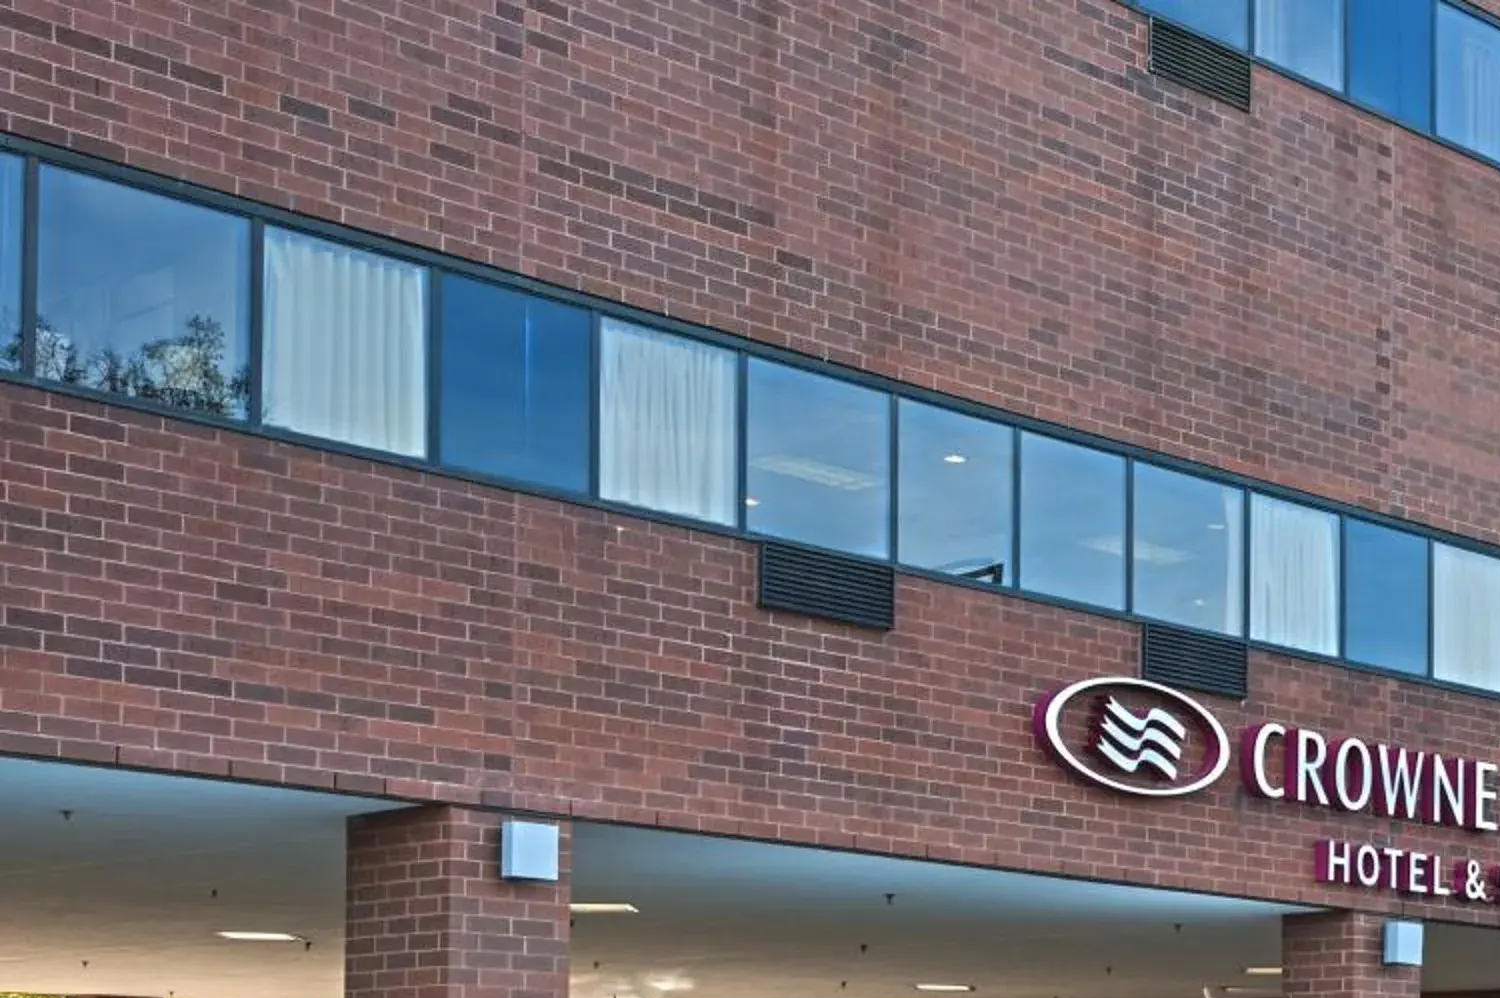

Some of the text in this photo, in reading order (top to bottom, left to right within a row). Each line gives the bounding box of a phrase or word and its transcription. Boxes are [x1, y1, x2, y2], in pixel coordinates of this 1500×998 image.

[1250, 721, 1499, 831] CROWNE
[1326, 839, 1451, 896] HOTEL
[1465, 858, 1487, 900] &
